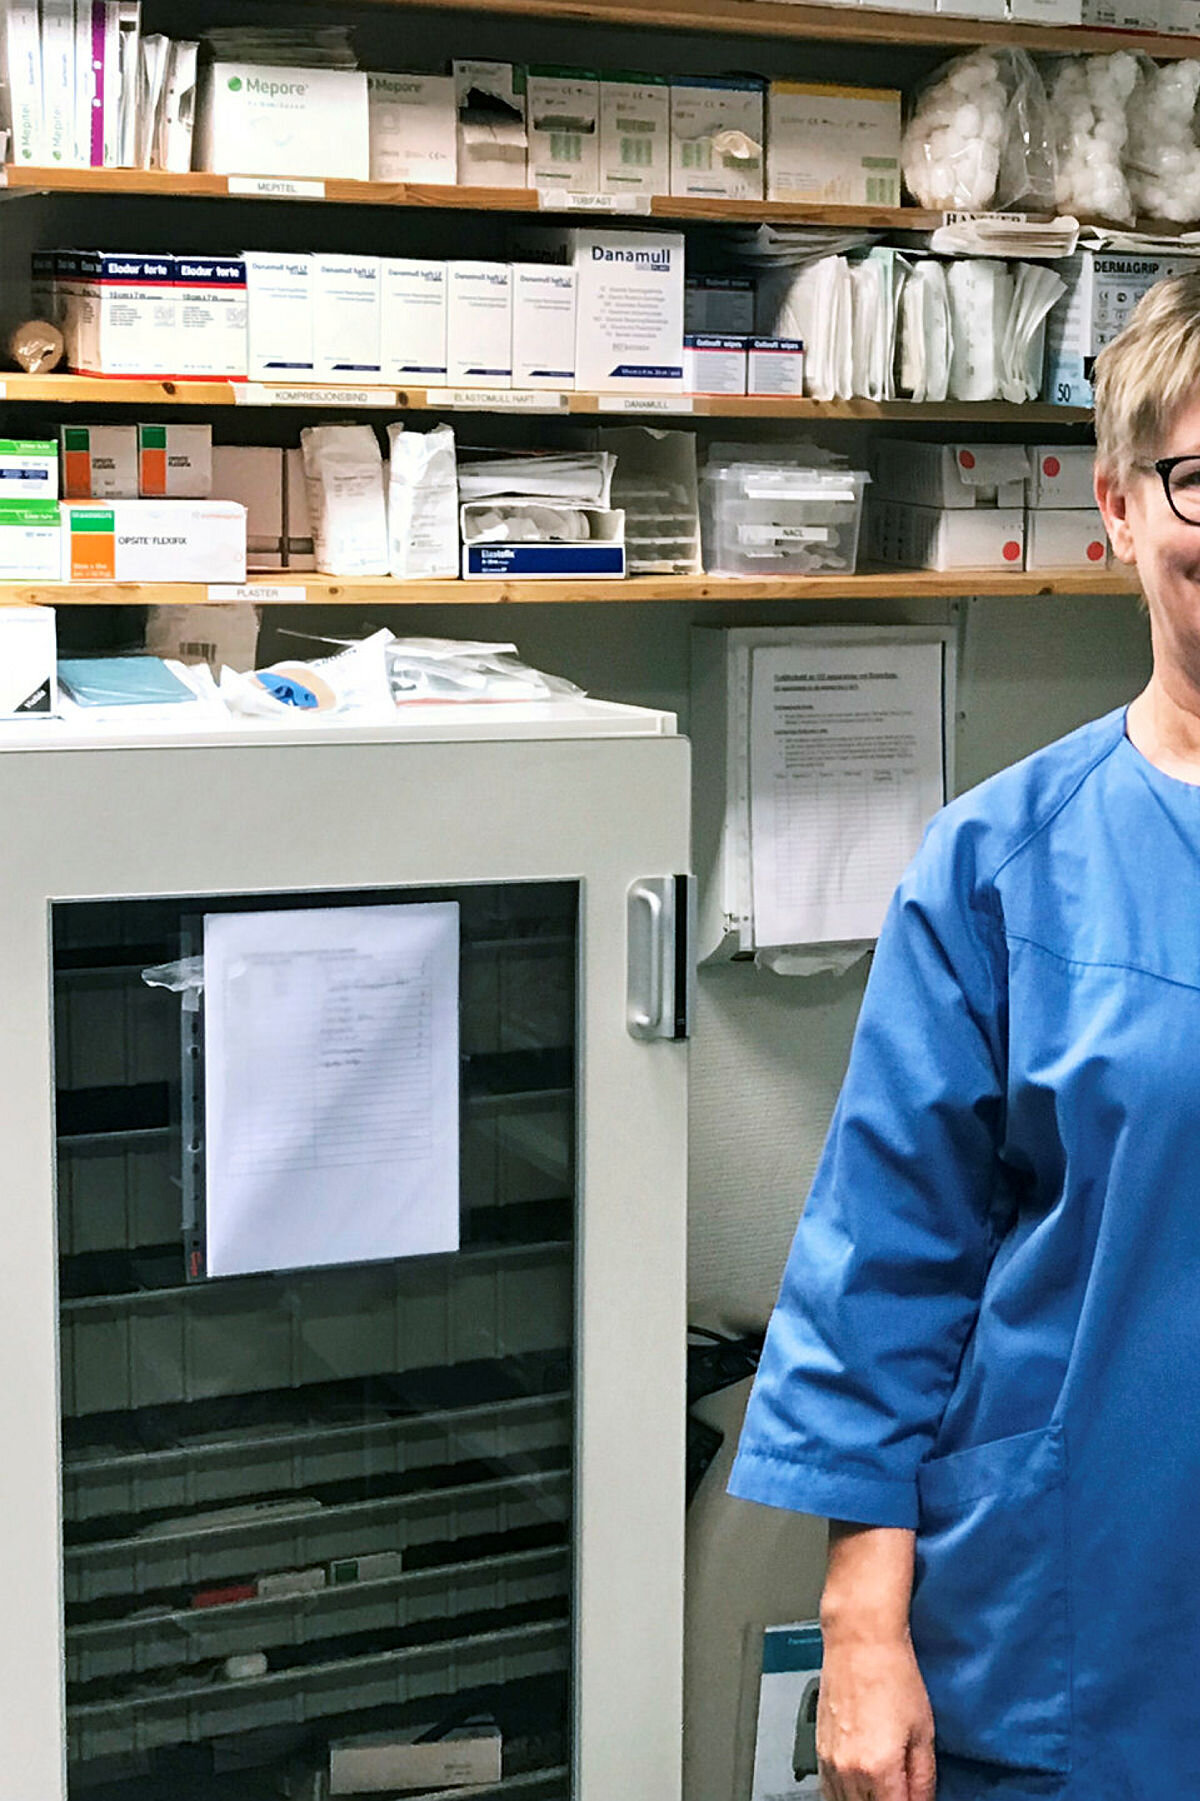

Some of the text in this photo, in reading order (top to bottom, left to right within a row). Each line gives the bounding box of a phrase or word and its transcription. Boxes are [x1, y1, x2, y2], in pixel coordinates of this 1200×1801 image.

[246, 78, 306, 97] Mepore
[375, 79, 423, 93] Mepore
[591, 245, 670, 263] Danamull
[1094, 260, 1160, 275] DERMAGRIP
[1057, 383, 1071, 403] 50
[237, 589, 279, 597] PLASTER
